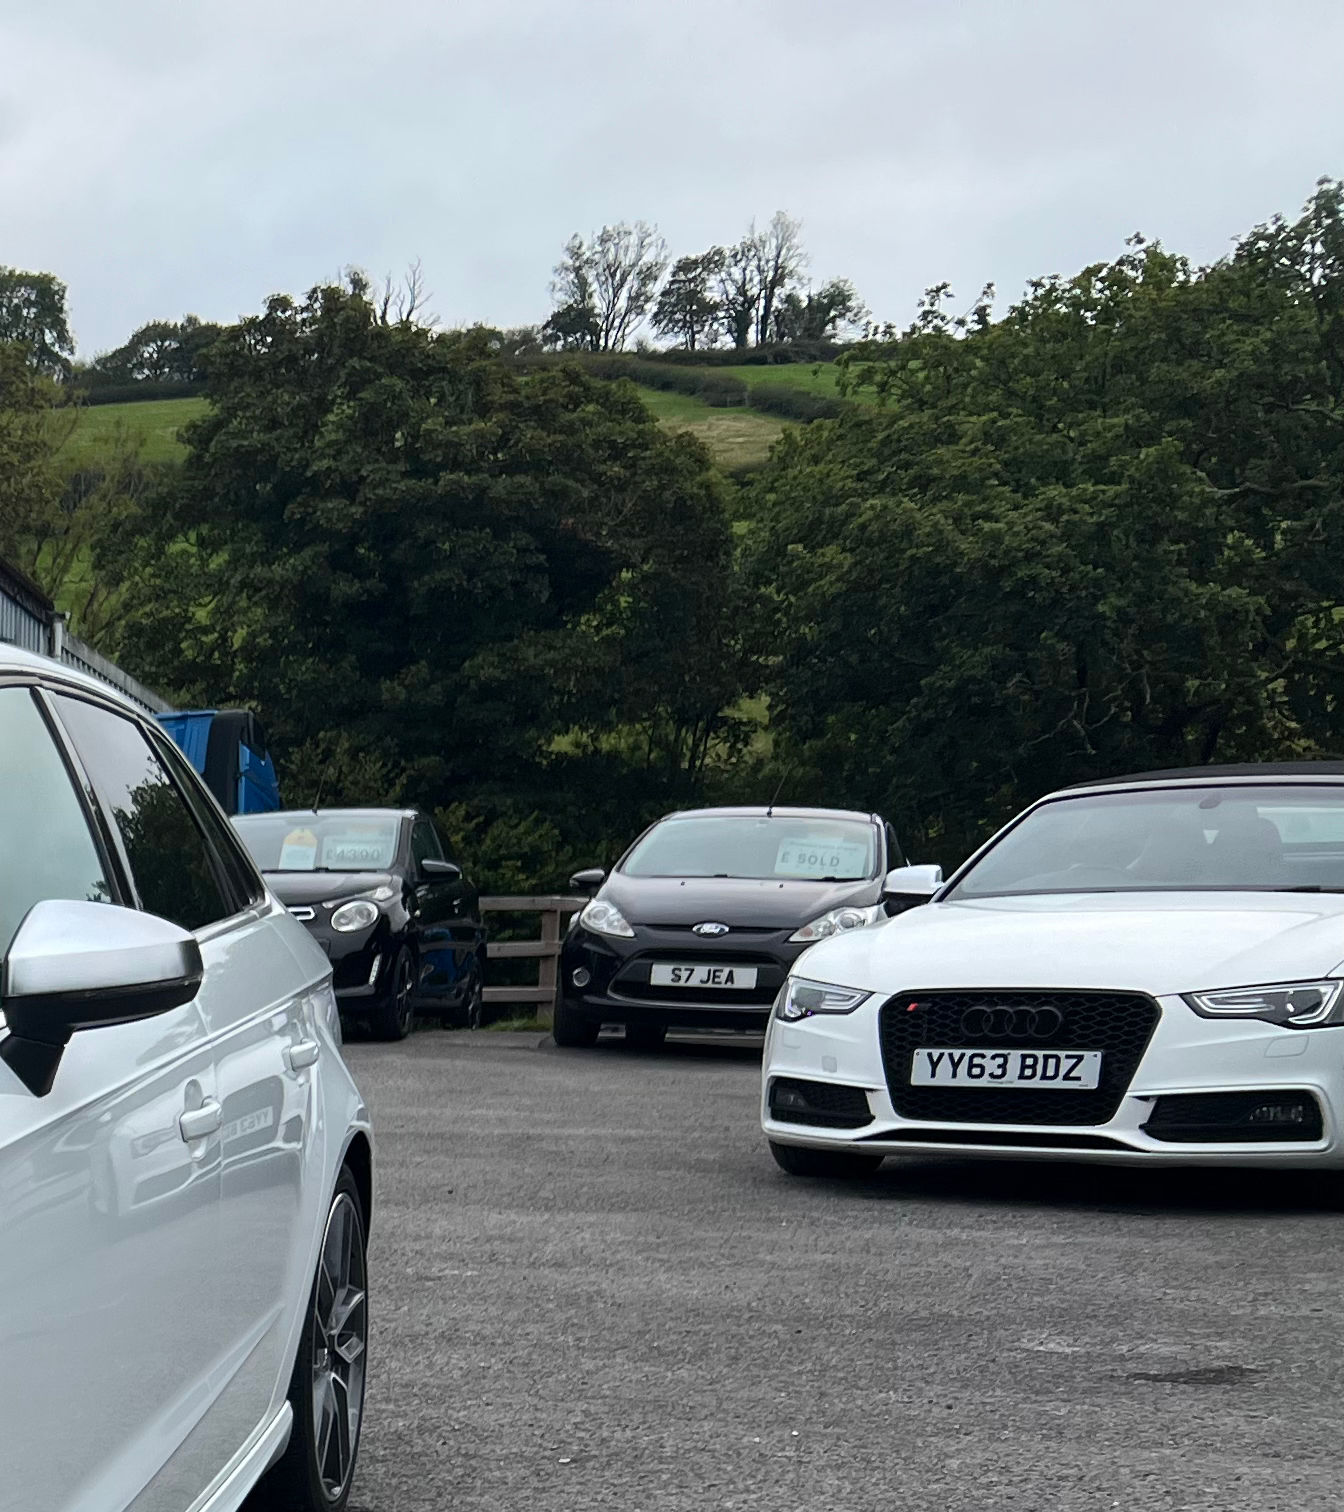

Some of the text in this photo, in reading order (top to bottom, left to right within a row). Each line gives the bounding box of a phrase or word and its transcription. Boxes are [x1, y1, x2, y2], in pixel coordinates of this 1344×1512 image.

[797, 852, 840, 867] SOLD
[670, 967, 735, 985] S7 JEA
[927, 1052, 1085, 1082] YY63 BDZ
